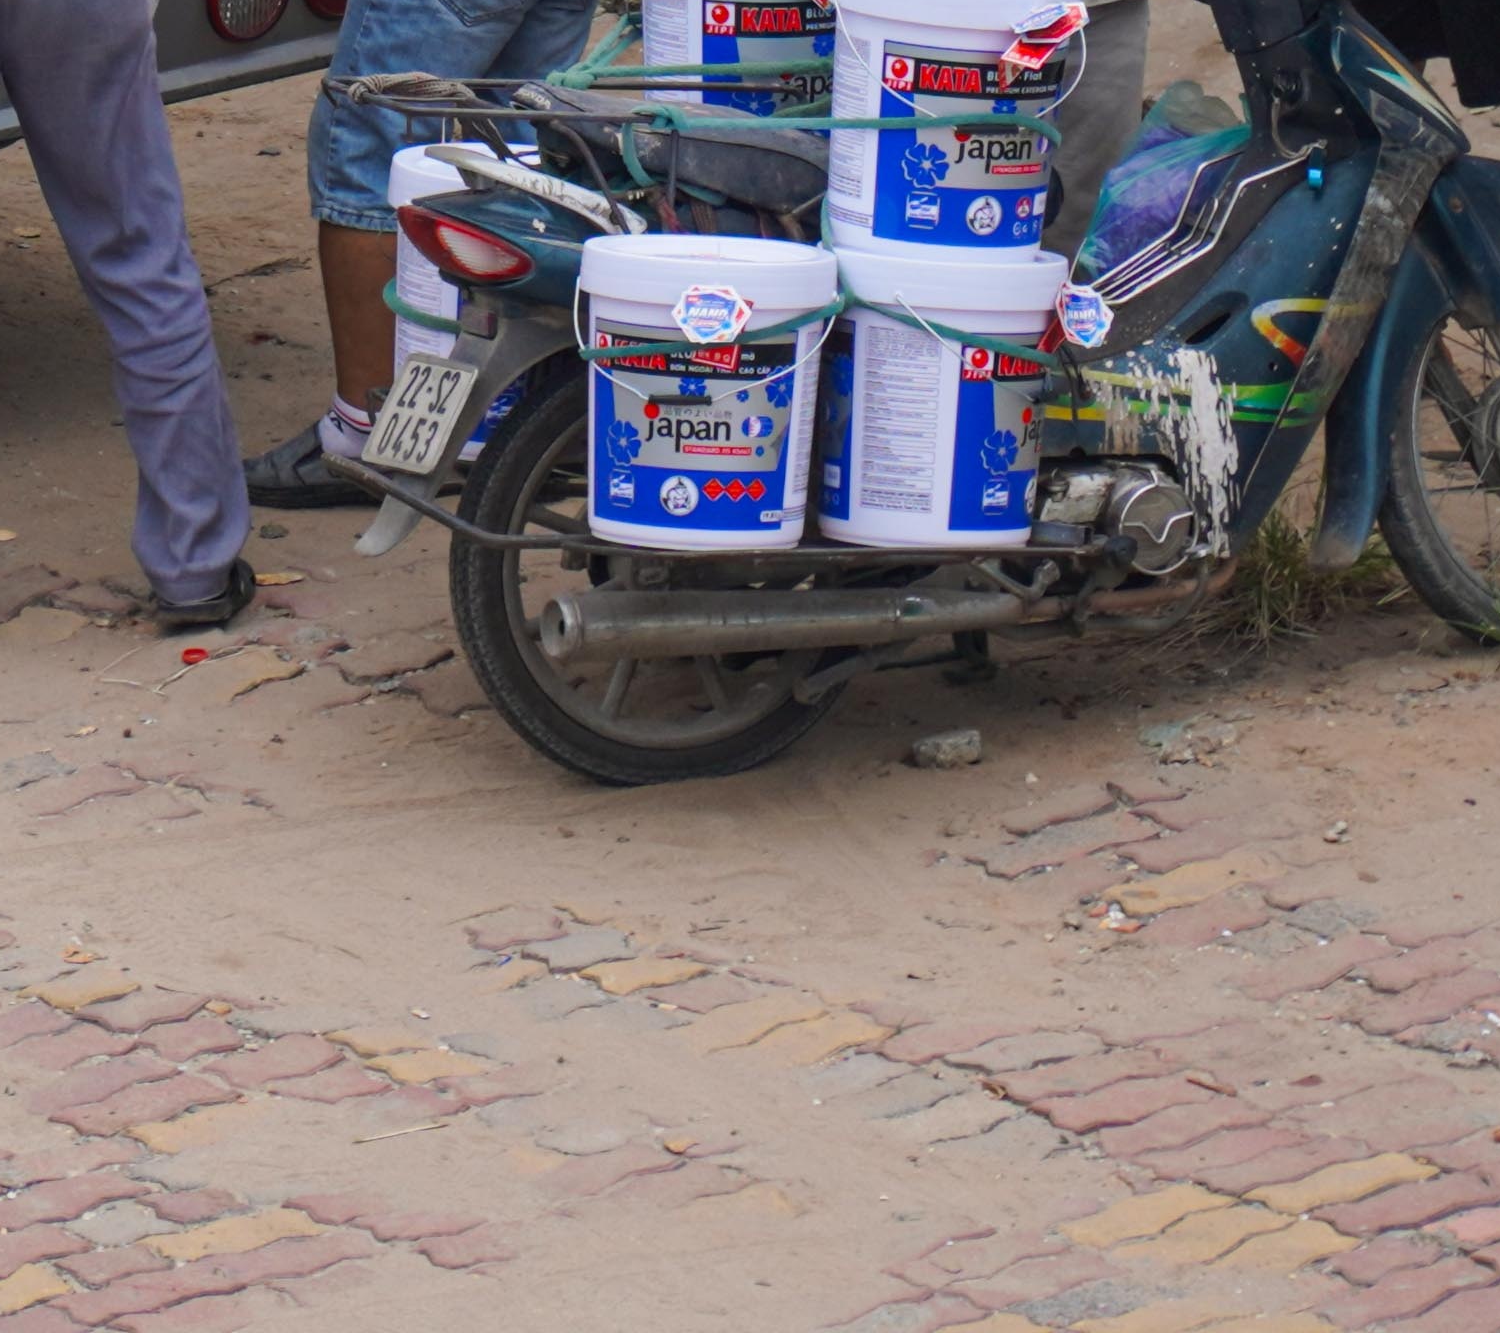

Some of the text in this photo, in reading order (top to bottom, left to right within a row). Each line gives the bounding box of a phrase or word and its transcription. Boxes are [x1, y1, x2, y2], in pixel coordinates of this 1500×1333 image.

[741, 6, 803, 33] KATA
[918, 63, 983, 94] KATA
[953, 131, 1033, 174] japan
[396, 365, 461, 414] 22-S2
[376, 412, 439, 463] 0453
[644, 402, 732, 454] japan
